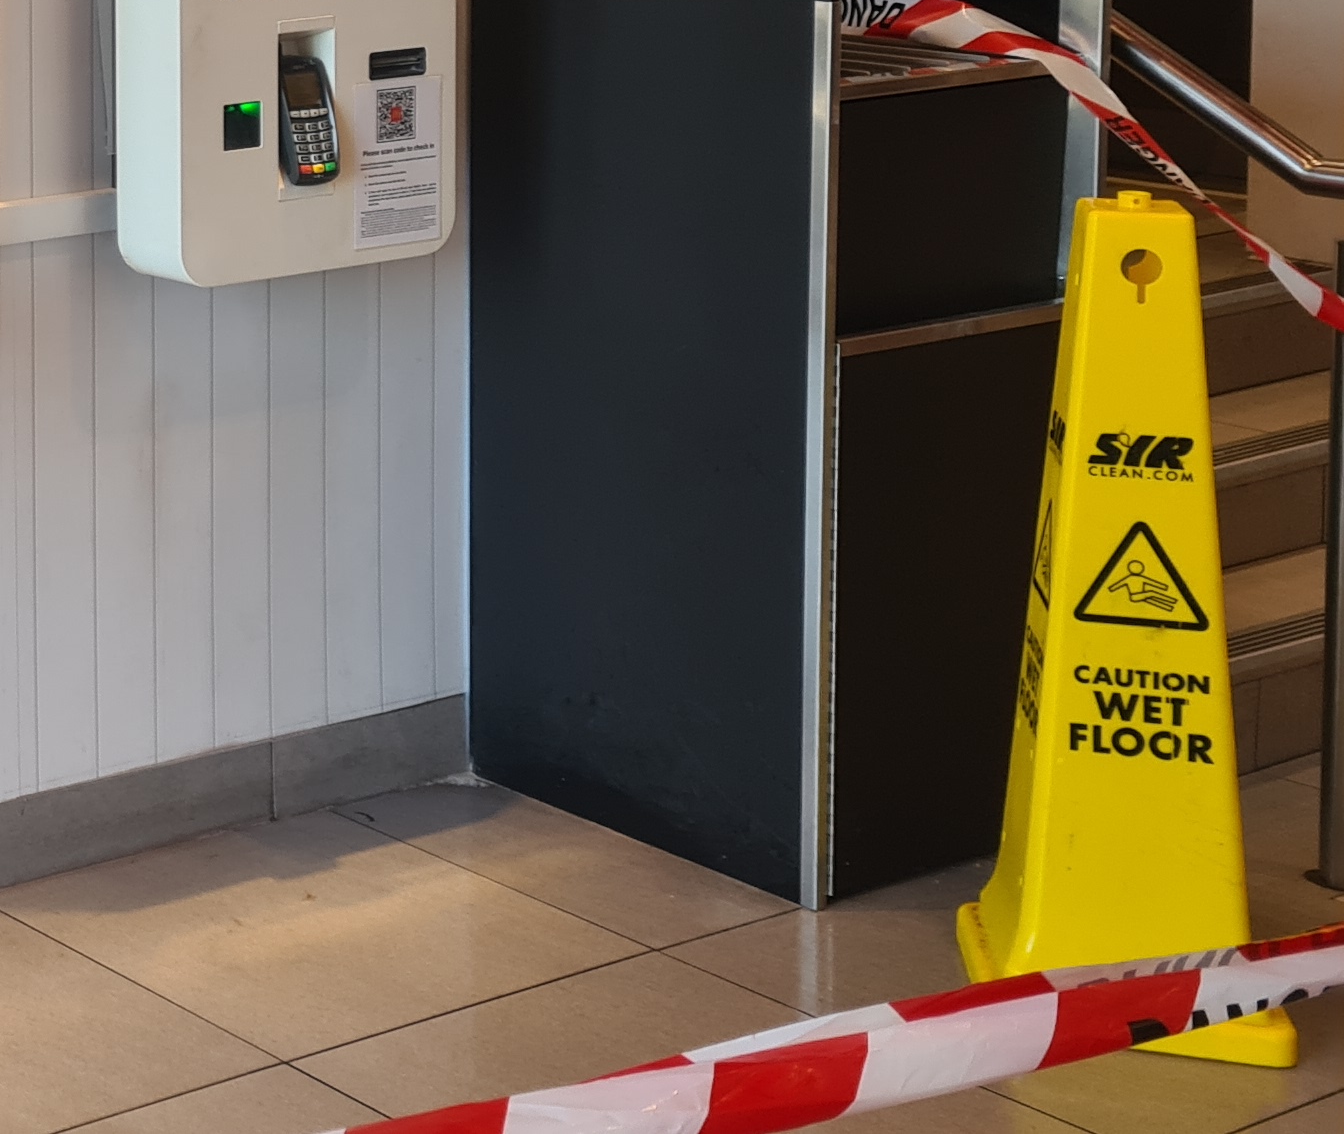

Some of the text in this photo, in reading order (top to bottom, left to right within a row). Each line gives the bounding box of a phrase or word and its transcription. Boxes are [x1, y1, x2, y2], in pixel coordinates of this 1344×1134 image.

[1088, 466, 1194, 482] CLEAN.COM
[1074, 665, 1210, 694] CAUTION
[1093, 691, 1189, 726] WET
[1070, 723, 1214, 764] FLOOR
